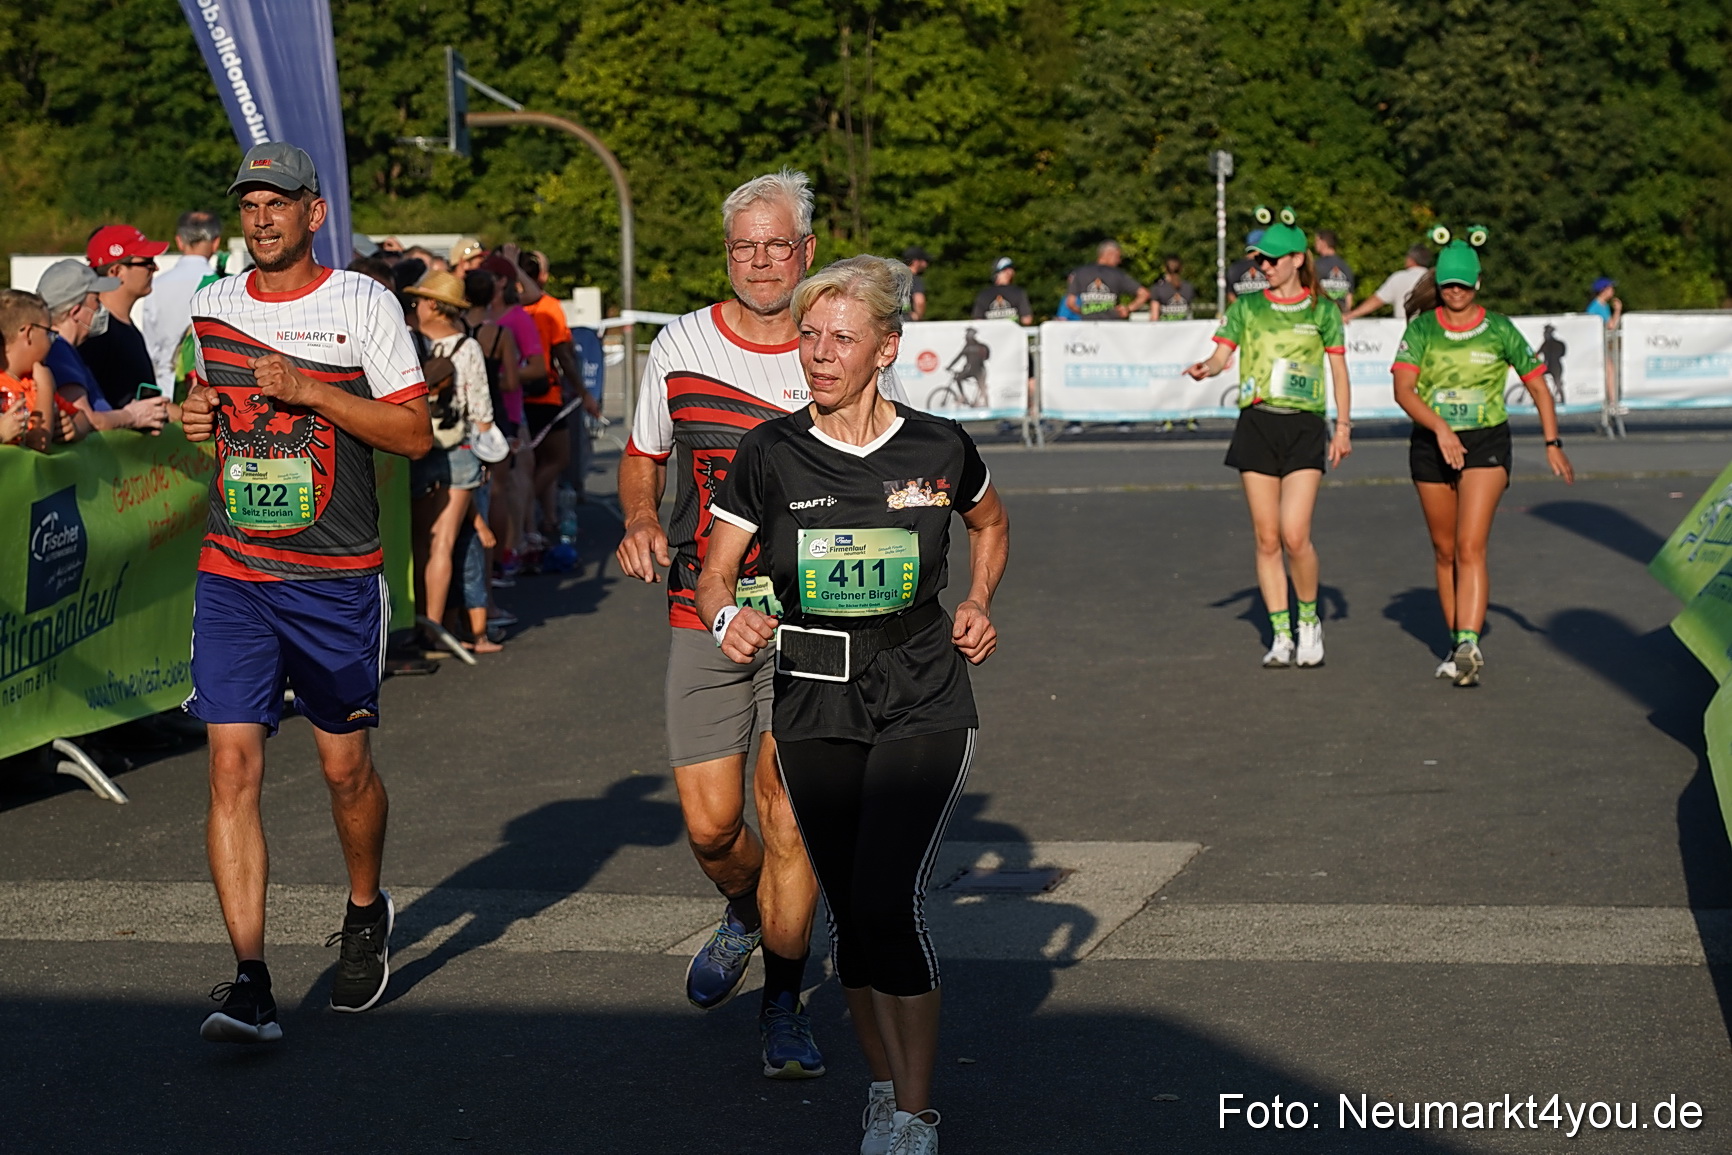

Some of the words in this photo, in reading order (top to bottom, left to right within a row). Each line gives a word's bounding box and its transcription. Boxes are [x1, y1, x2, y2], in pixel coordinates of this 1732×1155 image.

[276, 331, 335, 342] NEUMARKT
[1290, 374, 1307, 388] 50
[1449, 403, 1468, 416] 39
[228, 488, 237, 514] RUN
[244, 482, 289, 507] 122
[299, 487, 310, 518] 2022
[789, 498, 826, 510] CRAFT
[242, 507, 260, 517] Seitz
[262, 508, 293, 517] Florian
[829, 544, 867, 553] Firmenlauf
[806, 569, 816, 599] RUN
[828, 559, 886, 587] 411
[901, 562, 913, 600] 2022
[821, 591, 866, 600] Grebner
[869, 589, 898, 600] Birgit
[0, 561, 129, 680] firmenlauf
[3, 660, 57, 708] neumarkt
